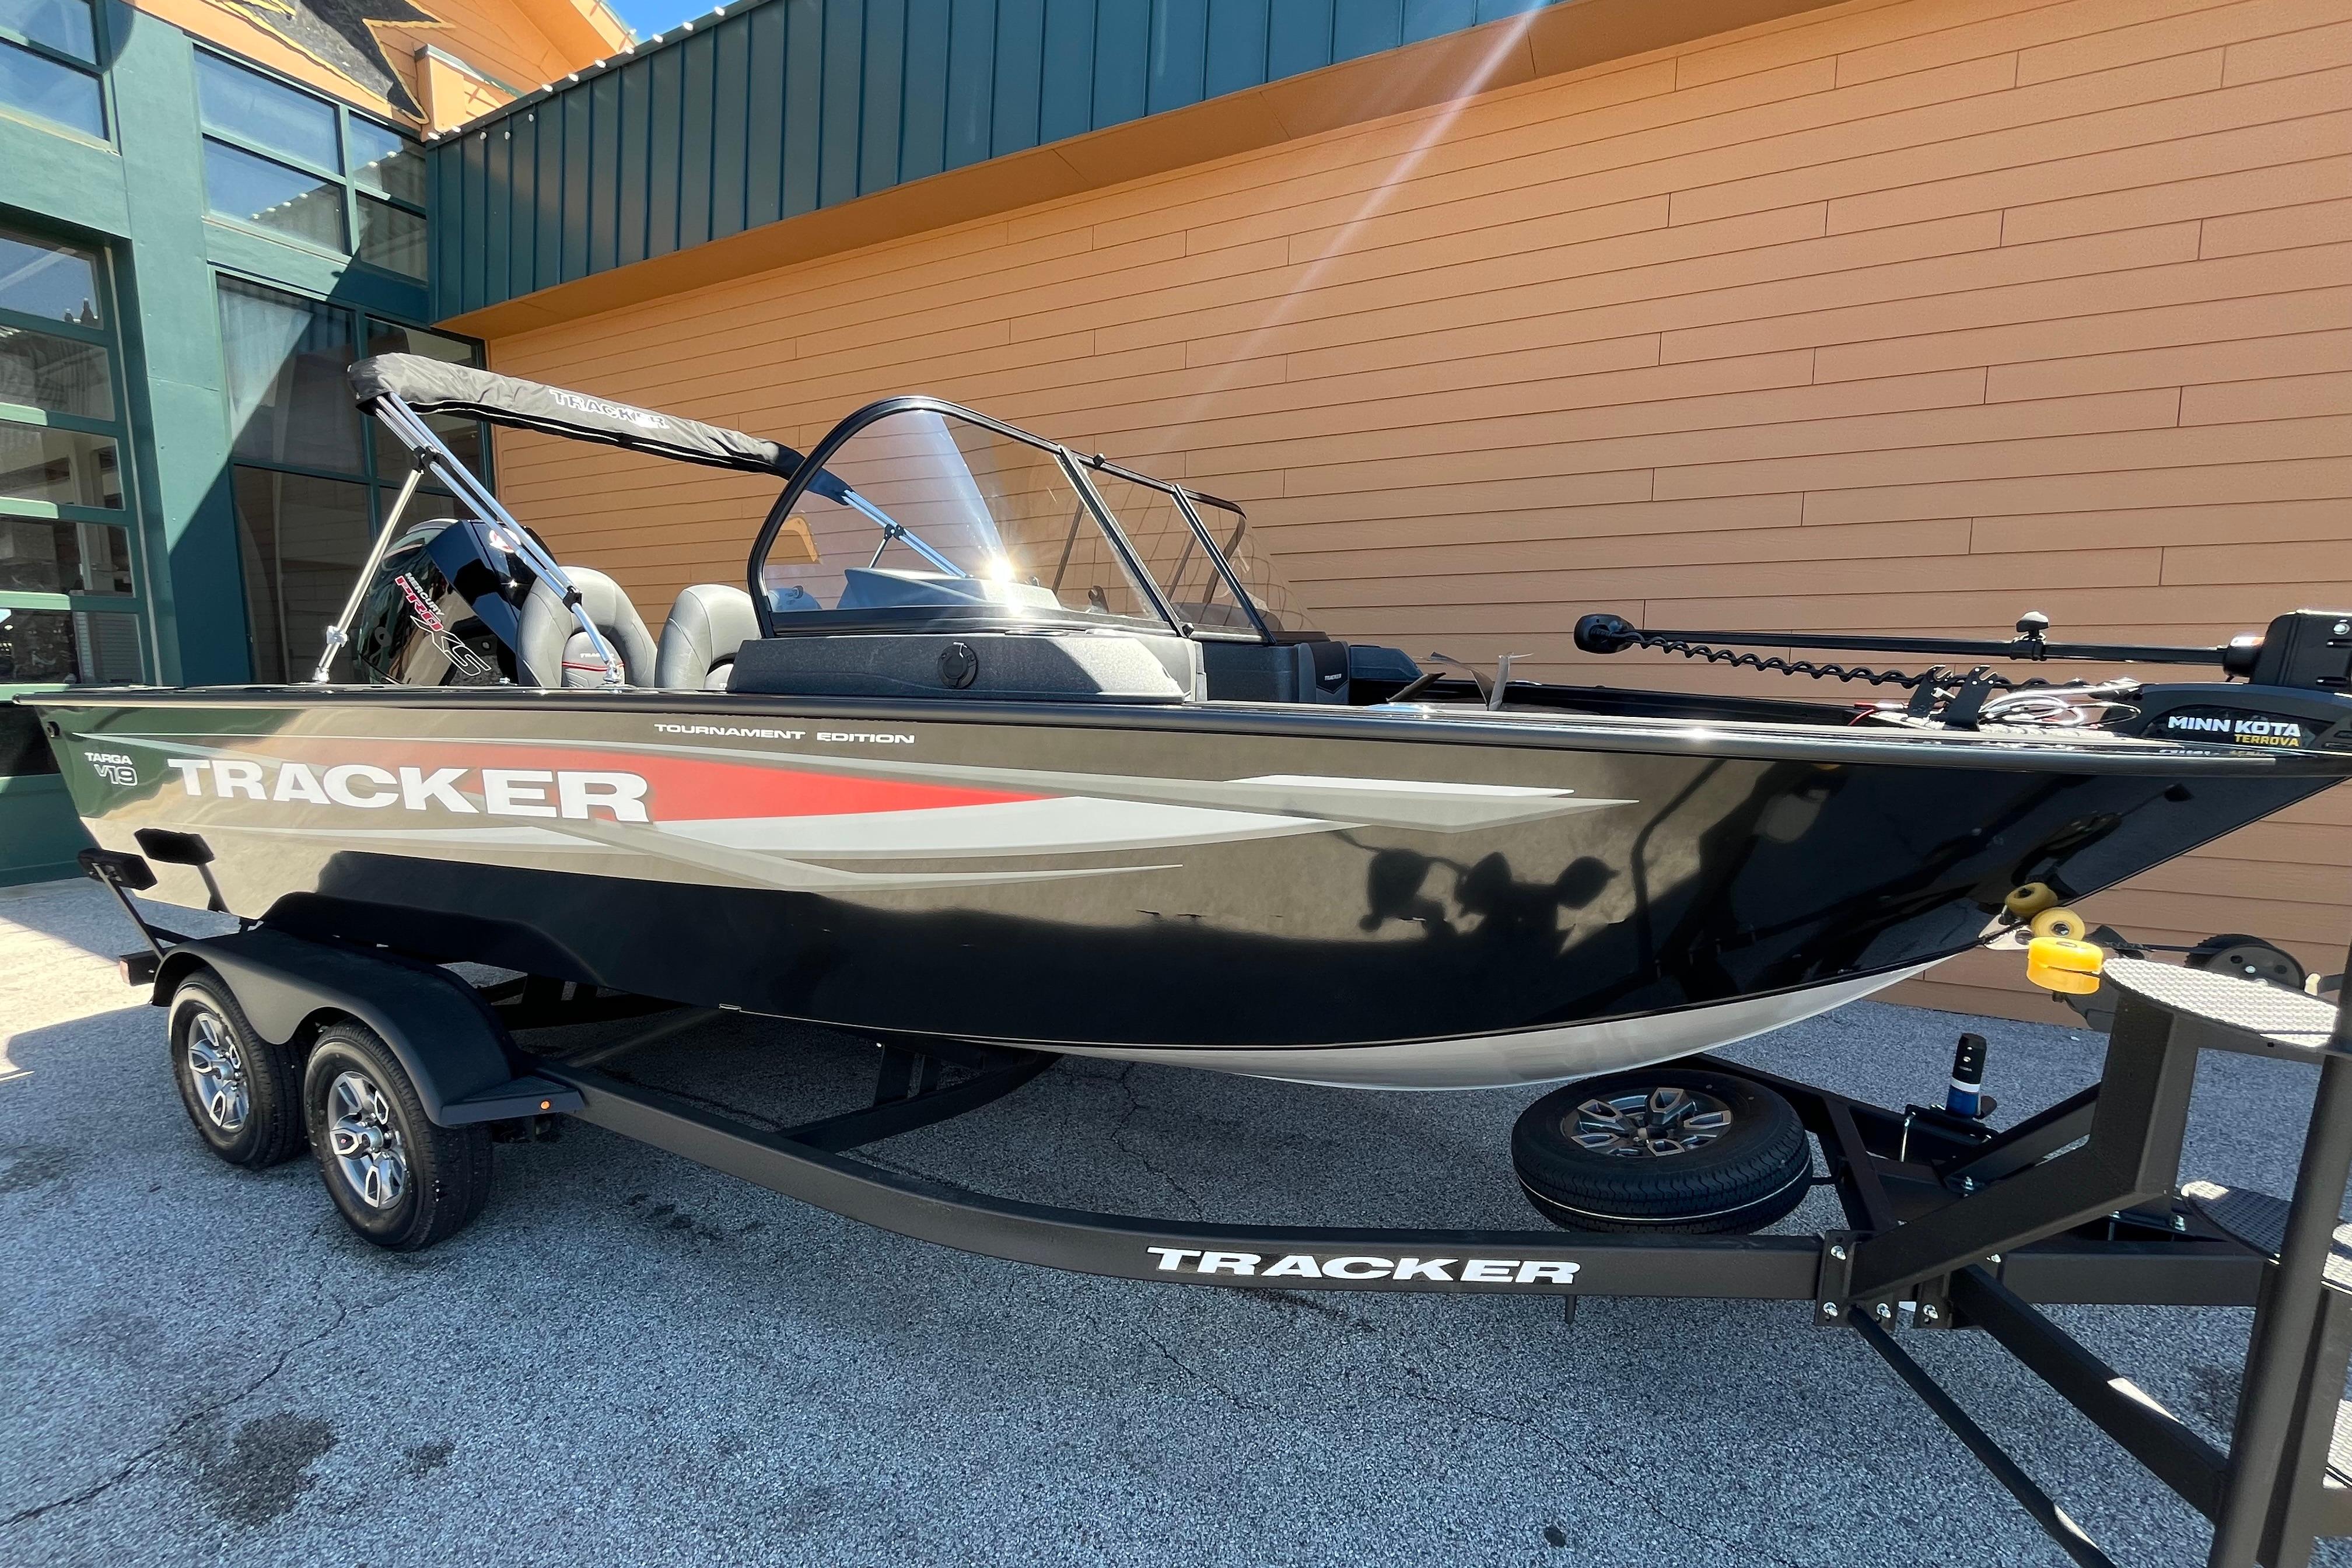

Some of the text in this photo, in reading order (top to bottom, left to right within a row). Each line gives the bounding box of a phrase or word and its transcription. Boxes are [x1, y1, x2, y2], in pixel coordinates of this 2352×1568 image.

[395, 575, 444, 632] PRO
[405, 572, 445, 616] MERCURY
[410, 615, 492, 677] XS
[654, 724, 915, 744] TOURNAMENT EDITION
[2168, 716, 2301, 737] MINN KOTA
[2234, 734, 2300, 747] TERROVA
[84, 752, 133, 765] TARGA
[93, 764, 138, 786] V19
[167, 758, 650, 822] TRACKER
[1146, 1247, 1581, 1284] TRACKER
